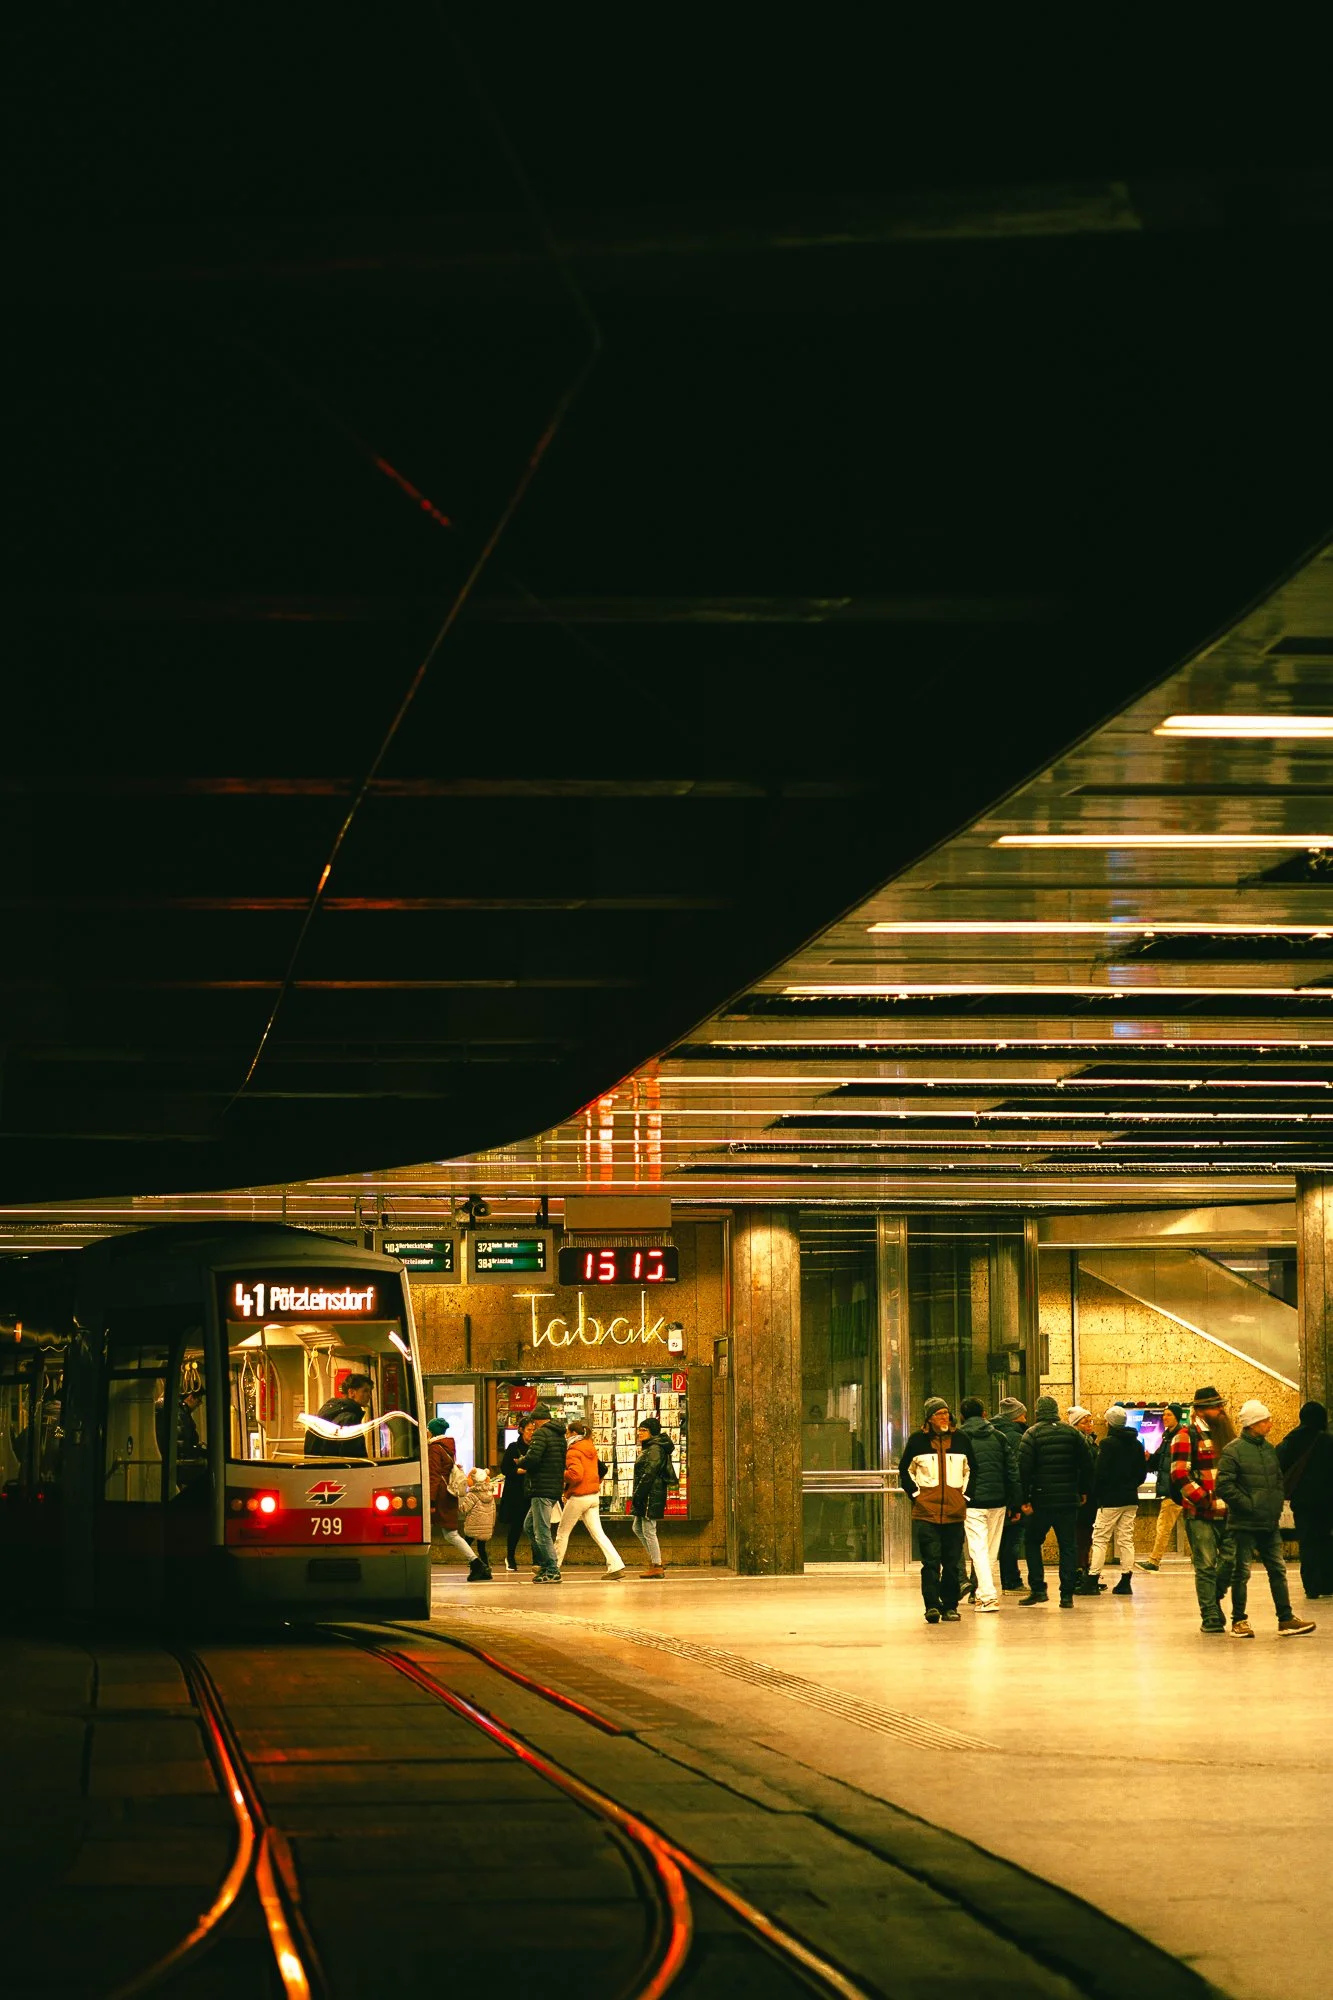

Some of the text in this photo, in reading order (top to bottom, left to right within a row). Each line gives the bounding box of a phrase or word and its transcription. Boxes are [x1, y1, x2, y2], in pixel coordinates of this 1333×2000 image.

[445, 1243, 451, 1253] 7
[537, 1242, 543, 1252] 9
[445, 1259, 451, 1269] 2
[537, 1258, 543, 1268] 4
[235, 1283, 375, 1317] 41 Pötzleinsdorf
[512, 1290, 667, 1348] Tabak
[310, 1517, 343, 1536] 799
